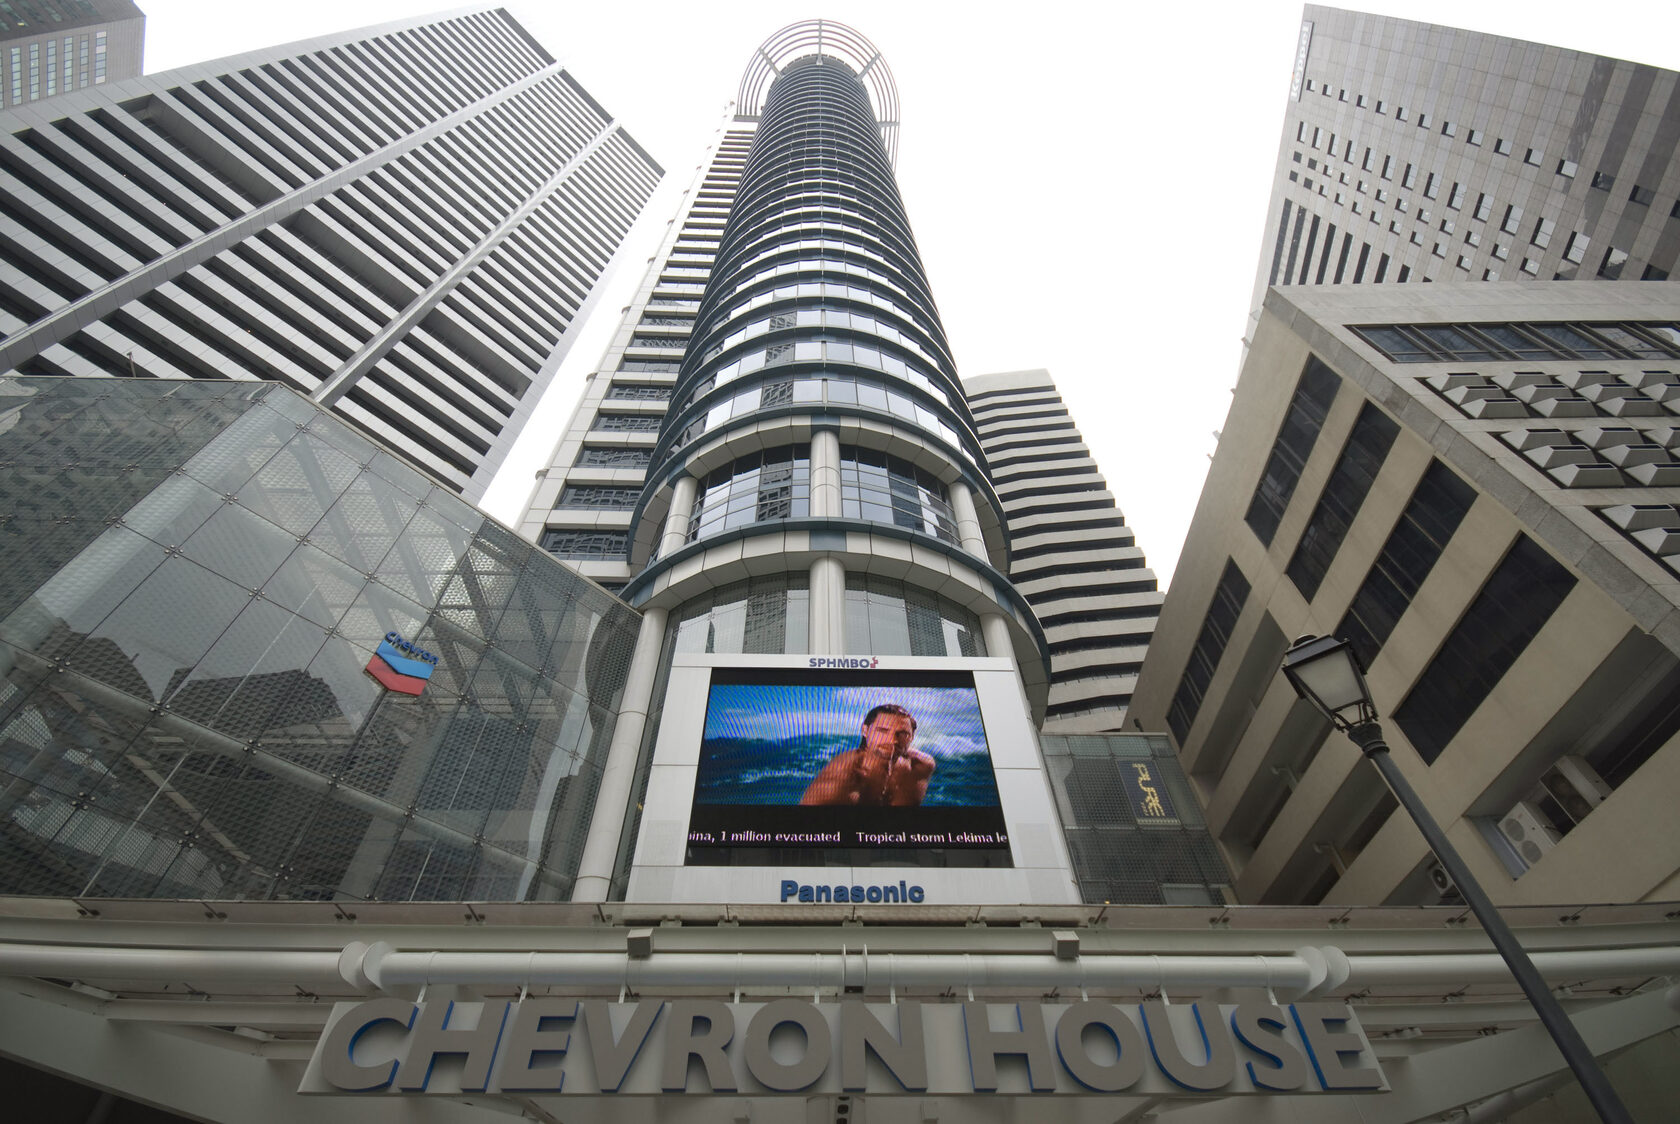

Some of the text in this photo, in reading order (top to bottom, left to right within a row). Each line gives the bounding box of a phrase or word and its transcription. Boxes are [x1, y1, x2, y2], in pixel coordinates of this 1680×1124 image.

[1290, 25, 1309, 97] Keppel
[385, 631, 439, 665] Chevron
[809, 657, 870, 669] SPHMBO
[1132, 763, 1165, 816] PURE
[720, 831, 727, 842] 1
[731, 830, 772, 842] million
[775, 831, 841, 842] evacuated
[855, 831, 906, 844] Tropical
[910, 832, 945, 843] storm
[948, 831, 993, 843] Lekima
[779, 879, 925, 903] Panasonic
[321, 1000, 1384, 1092] CHEVRON HOUSE
